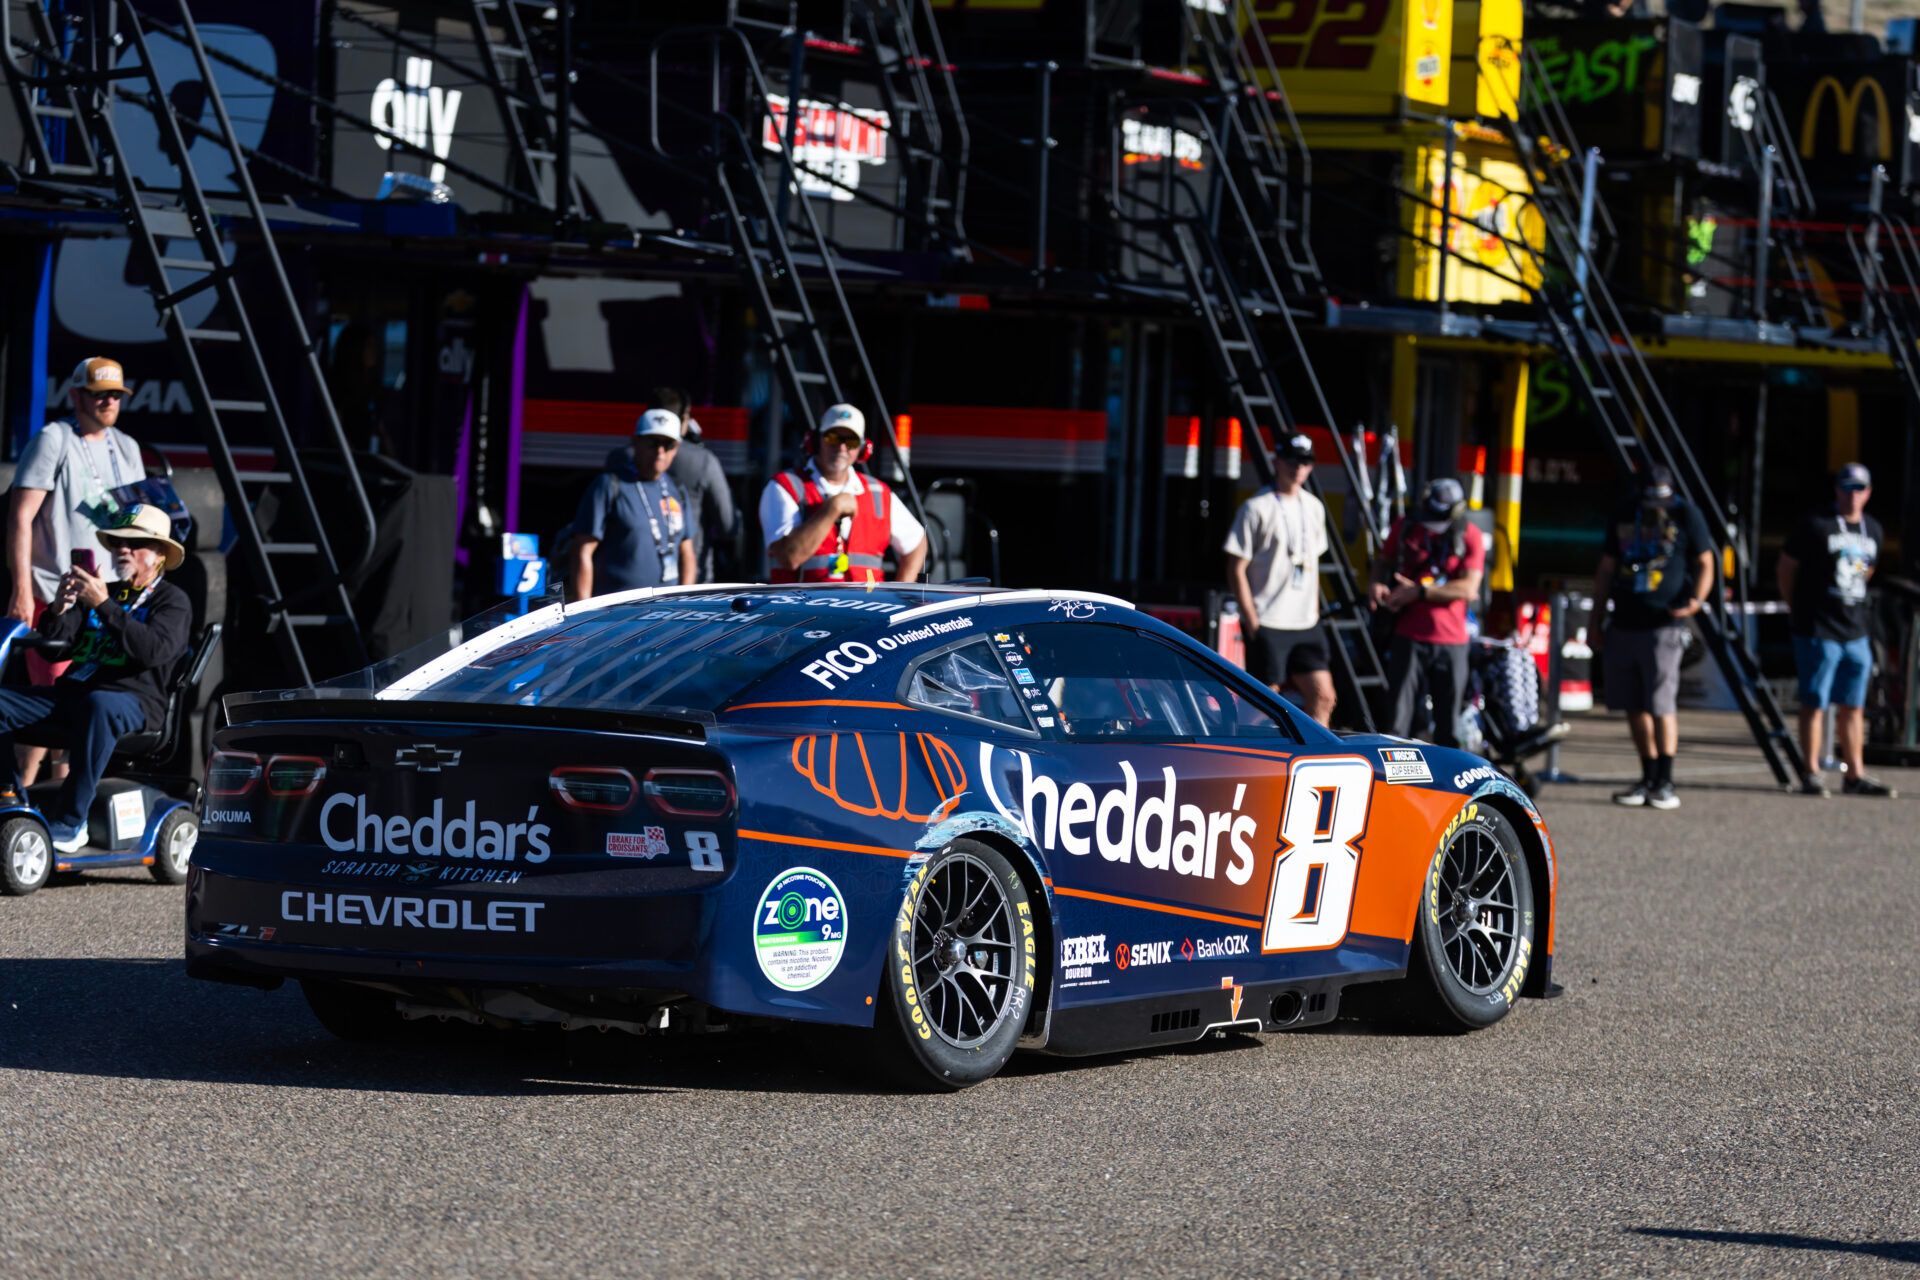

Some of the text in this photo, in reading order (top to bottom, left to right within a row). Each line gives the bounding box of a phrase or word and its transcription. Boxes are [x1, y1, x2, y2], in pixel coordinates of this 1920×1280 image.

[1240, 0, 1392, 70] 22
[1527, 36, 1656, 107] EAST
[371, 57, 462, 183] ally
[517, 560, 543, 593] 5
[638, 610, 764, 623] BUSCH
[893, 616, 973, 645] United Rentals
[800, 641, 877, 691] FICO
[1394, 750, 1418, 761] NASCAR
[1403, 766, 1424, 775] SERIES
[211, 810, 251, 823] OKUMA
[319, 792, 551, 864] Cheddar's
[979, 741, 1257, 886] Cheddar's
[608, 844, 648, 853] CROISSANTS
[612, 835, 632, 844] BRAKE
[633, 836, 646, 845] FOR
[683, 830, 725, 872] 8
[1261, 754, 1373, 955] 8
[322, 860, 400, 877] SCRATCH
[439, 867, 522, 884] KITCHEN
[782, 874, 804, 886] NICOTINE
[805, 874, 827, 889] POUCHES
[281, 890, 545, 933] CHEVROLET
[214, 922, 277, 941] ZL1
[768, 958, 788, 966] contains
[811, 955, 833, 963] Nicotine
[810, 948, 829, 956] product
[1017, 901, 1036, 992] EAGLE
[1060, 934, 1111, 968] EBEL
[1130, 941, 1172, 967] SENIX
[1065, 966, 1092, 980] BOURBON
[1503, 935, 1532, 1004] EAGLE
